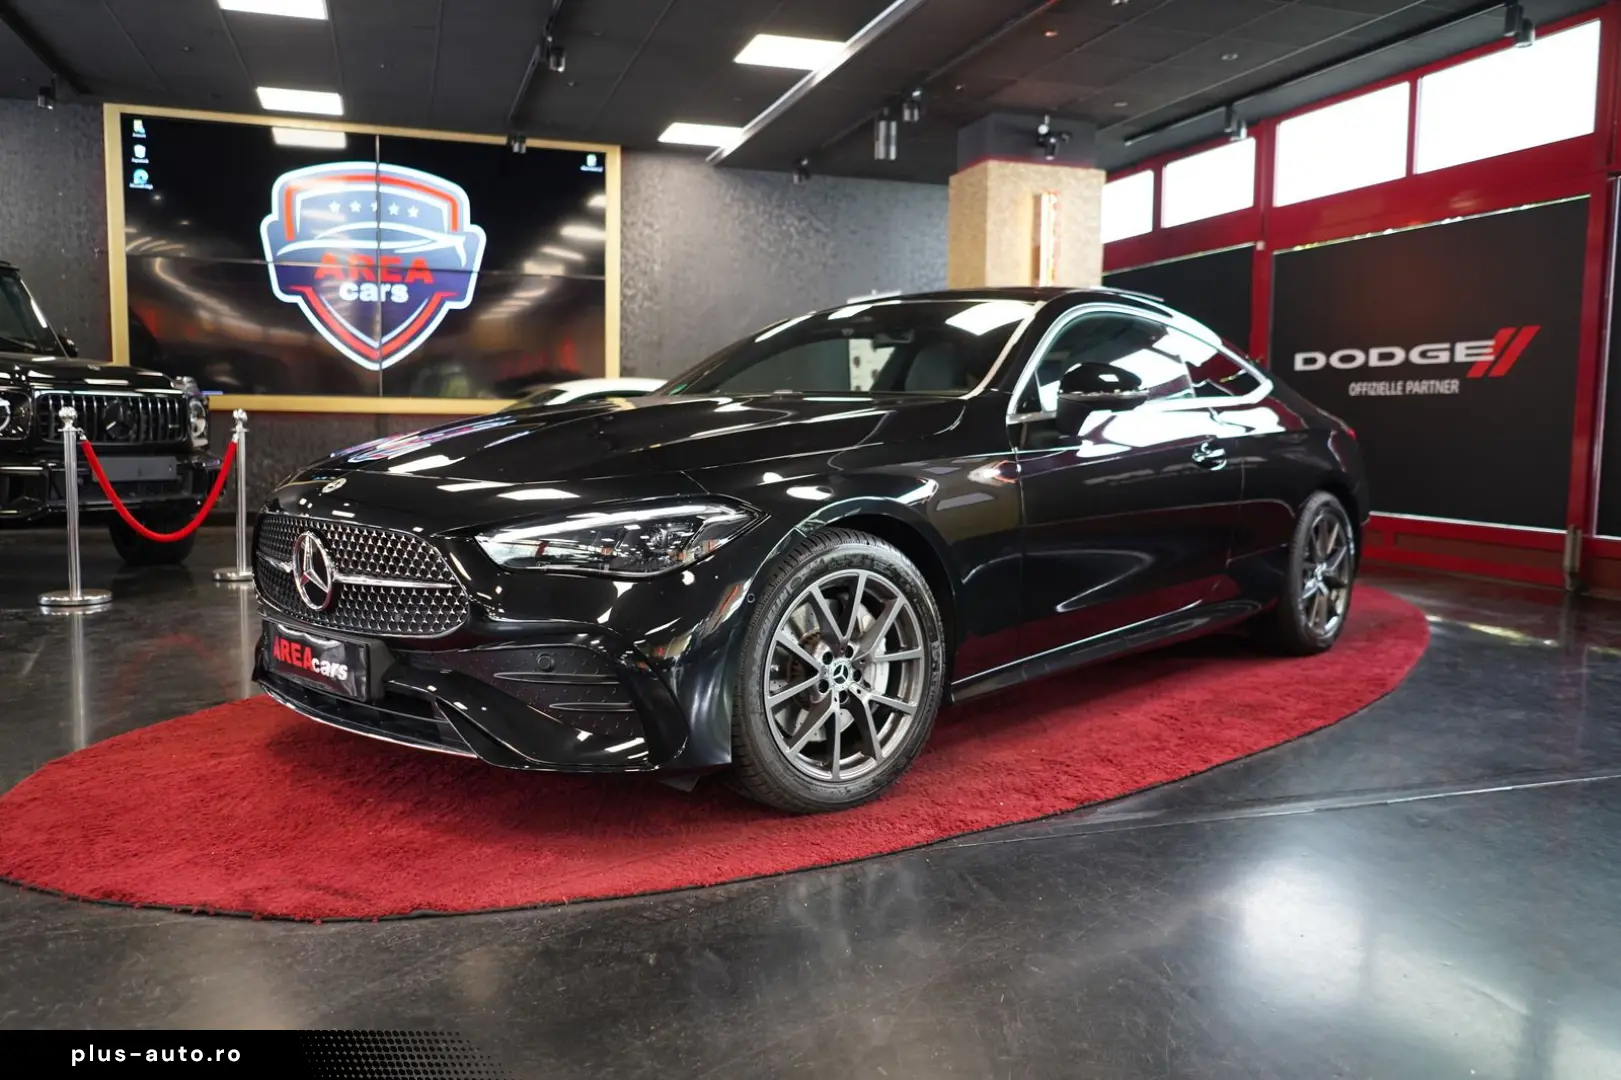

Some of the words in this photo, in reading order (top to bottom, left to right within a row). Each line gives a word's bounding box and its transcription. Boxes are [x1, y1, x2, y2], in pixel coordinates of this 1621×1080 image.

[314, 252, 434, 284] AREA
[339, 282, 409, 303] cars
[1294, 339, 1496, 371] DODGE
[1348, 380, 1404, 396] OFFIZIELLE
[1405, 379, 1460, 395] PARTNER
